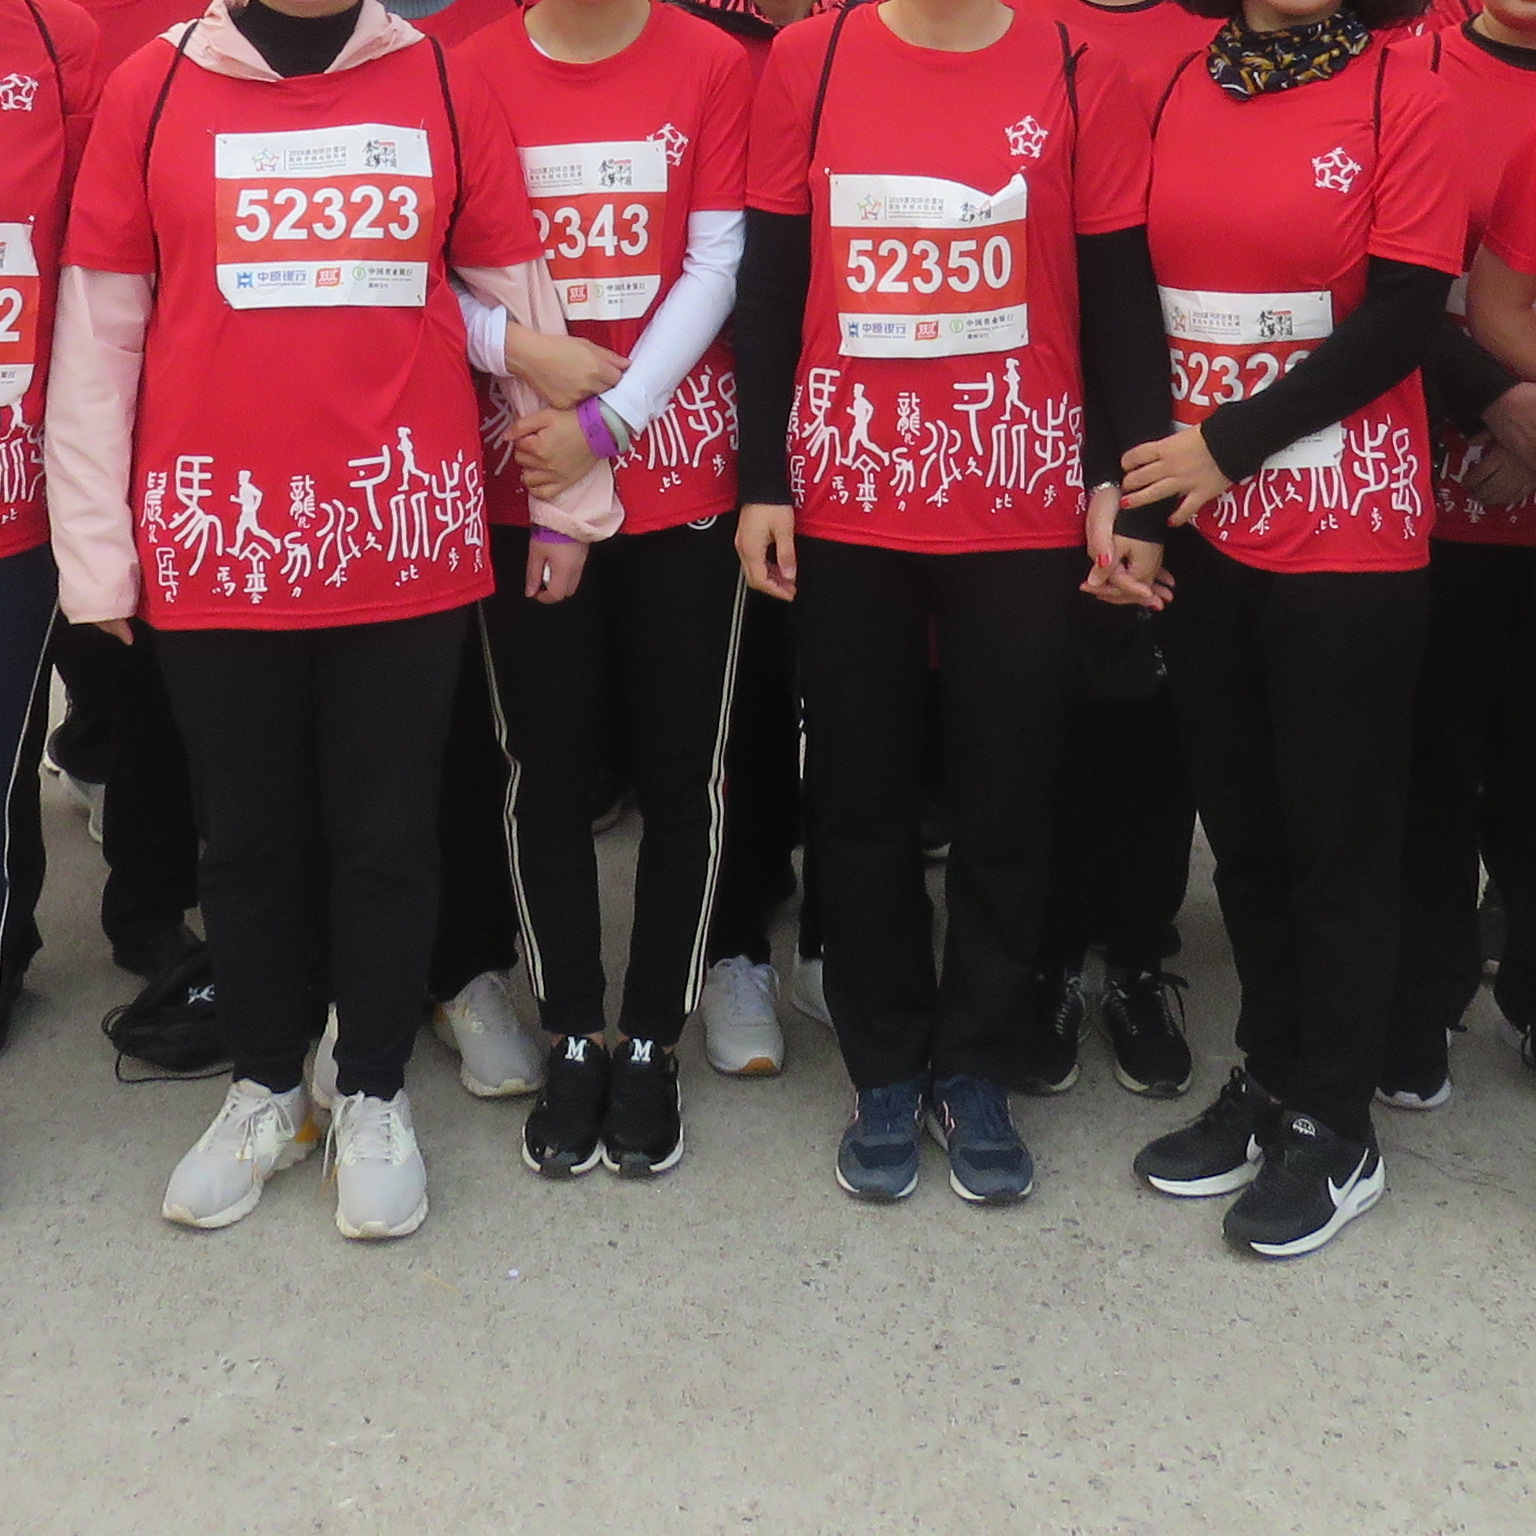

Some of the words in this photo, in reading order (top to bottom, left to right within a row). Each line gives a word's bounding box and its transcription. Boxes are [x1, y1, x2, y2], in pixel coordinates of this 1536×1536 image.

[235, 185, 420, 242] 52323
[532, 203, 650, 260] 343
[846, 235, 1013, 294] 52350
[564, 1036, 589, 1063] M
[630, 1038, 655, 1063] M
